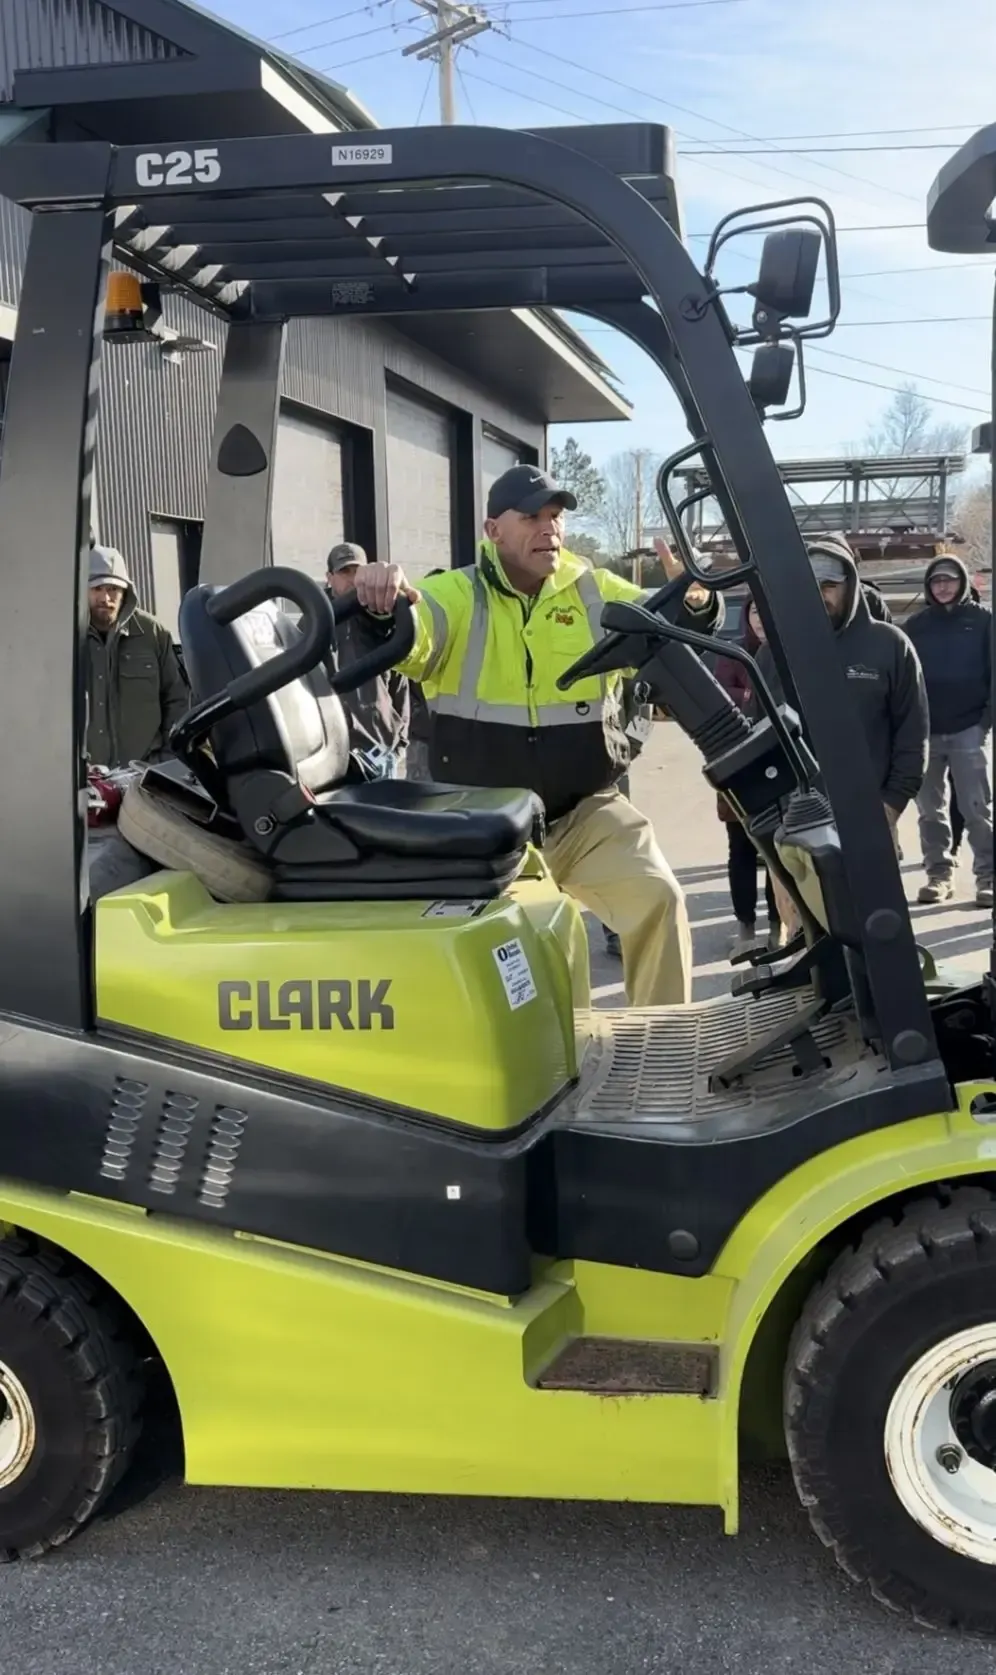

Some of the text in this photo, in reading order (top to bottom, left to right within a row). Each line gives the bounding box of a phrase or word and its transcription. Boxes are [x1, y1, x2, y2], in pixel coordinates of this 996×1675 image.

[135, 148, 221, 187] C25
[338, 148, 385, 161] N16929
[218, 979, 394, 1030] CLARK
